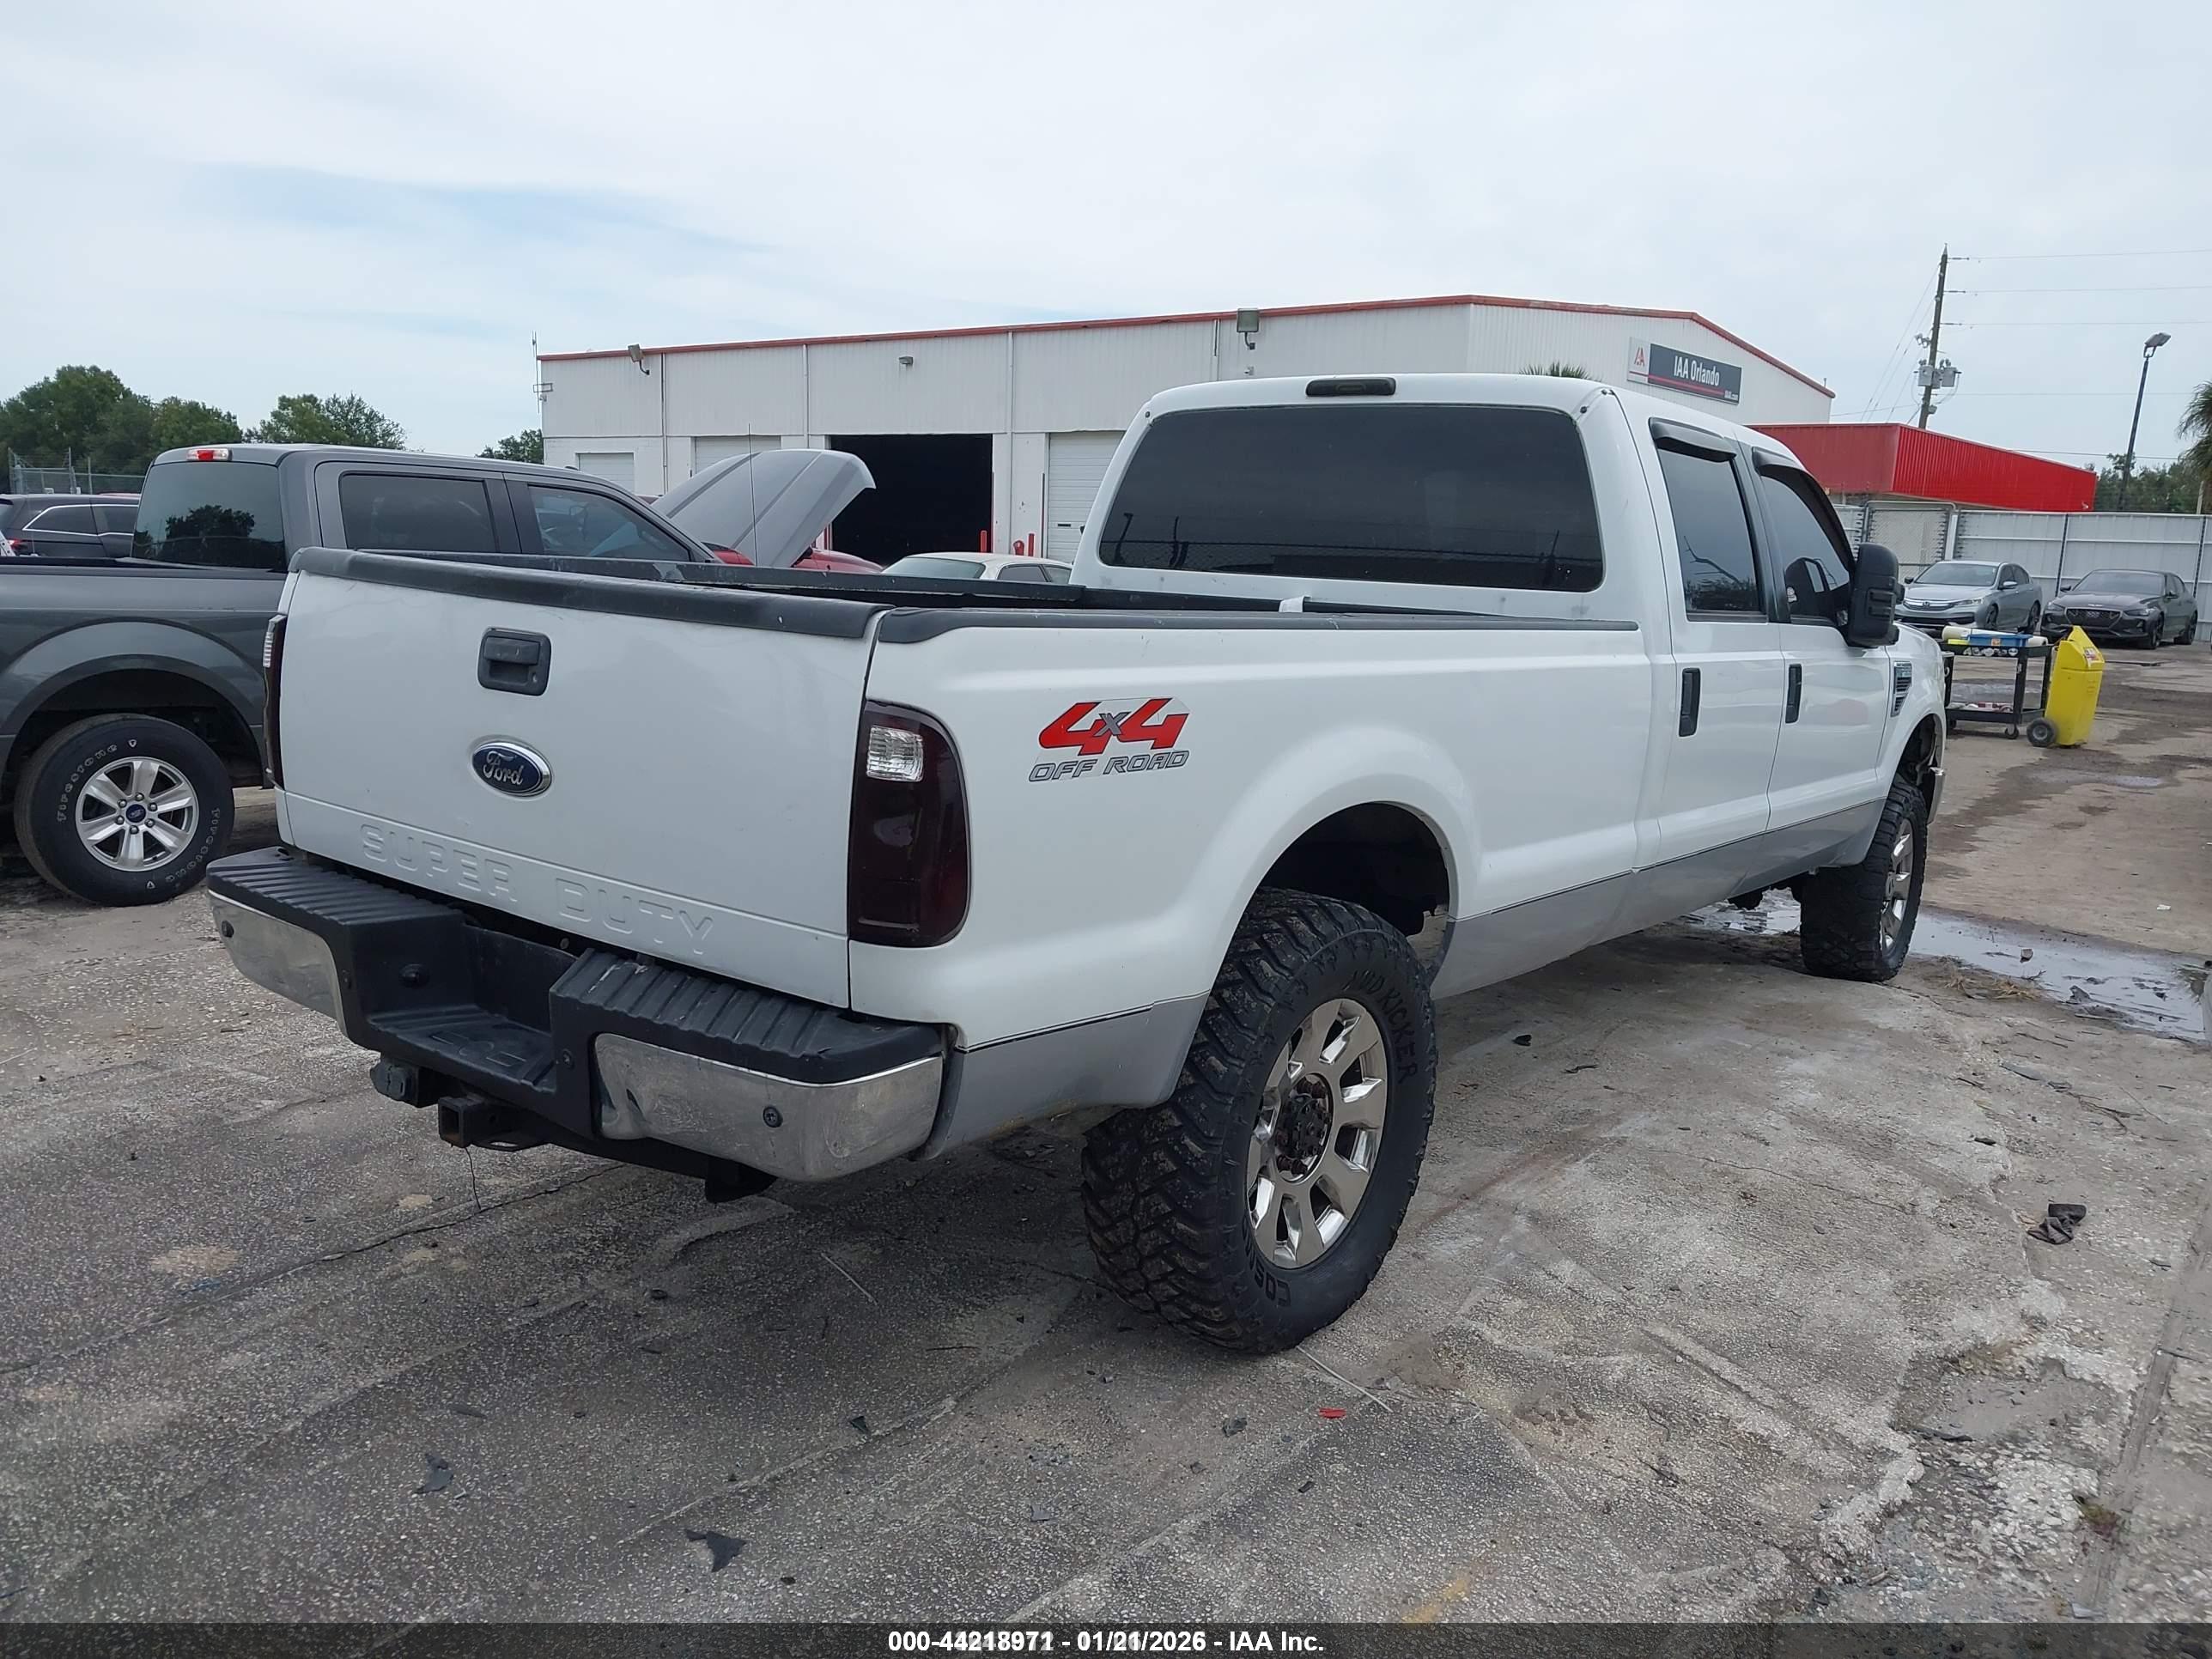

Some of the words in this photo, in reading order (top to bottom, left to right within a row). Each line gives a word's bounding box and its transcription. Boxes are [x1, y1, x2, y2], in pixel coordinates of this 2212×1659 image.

[1674, 356, 1689, 379] IAA
[1690, 360, 1720, 386] Orlando
[483, 750, 525, 786] Ford
[1029, 759, 1098, 782] OFF
[1103, 750, 1190, 775] ROAD
[359, 823, 520, 903] SUPER
[555, 877, 715, 956] DUTY
